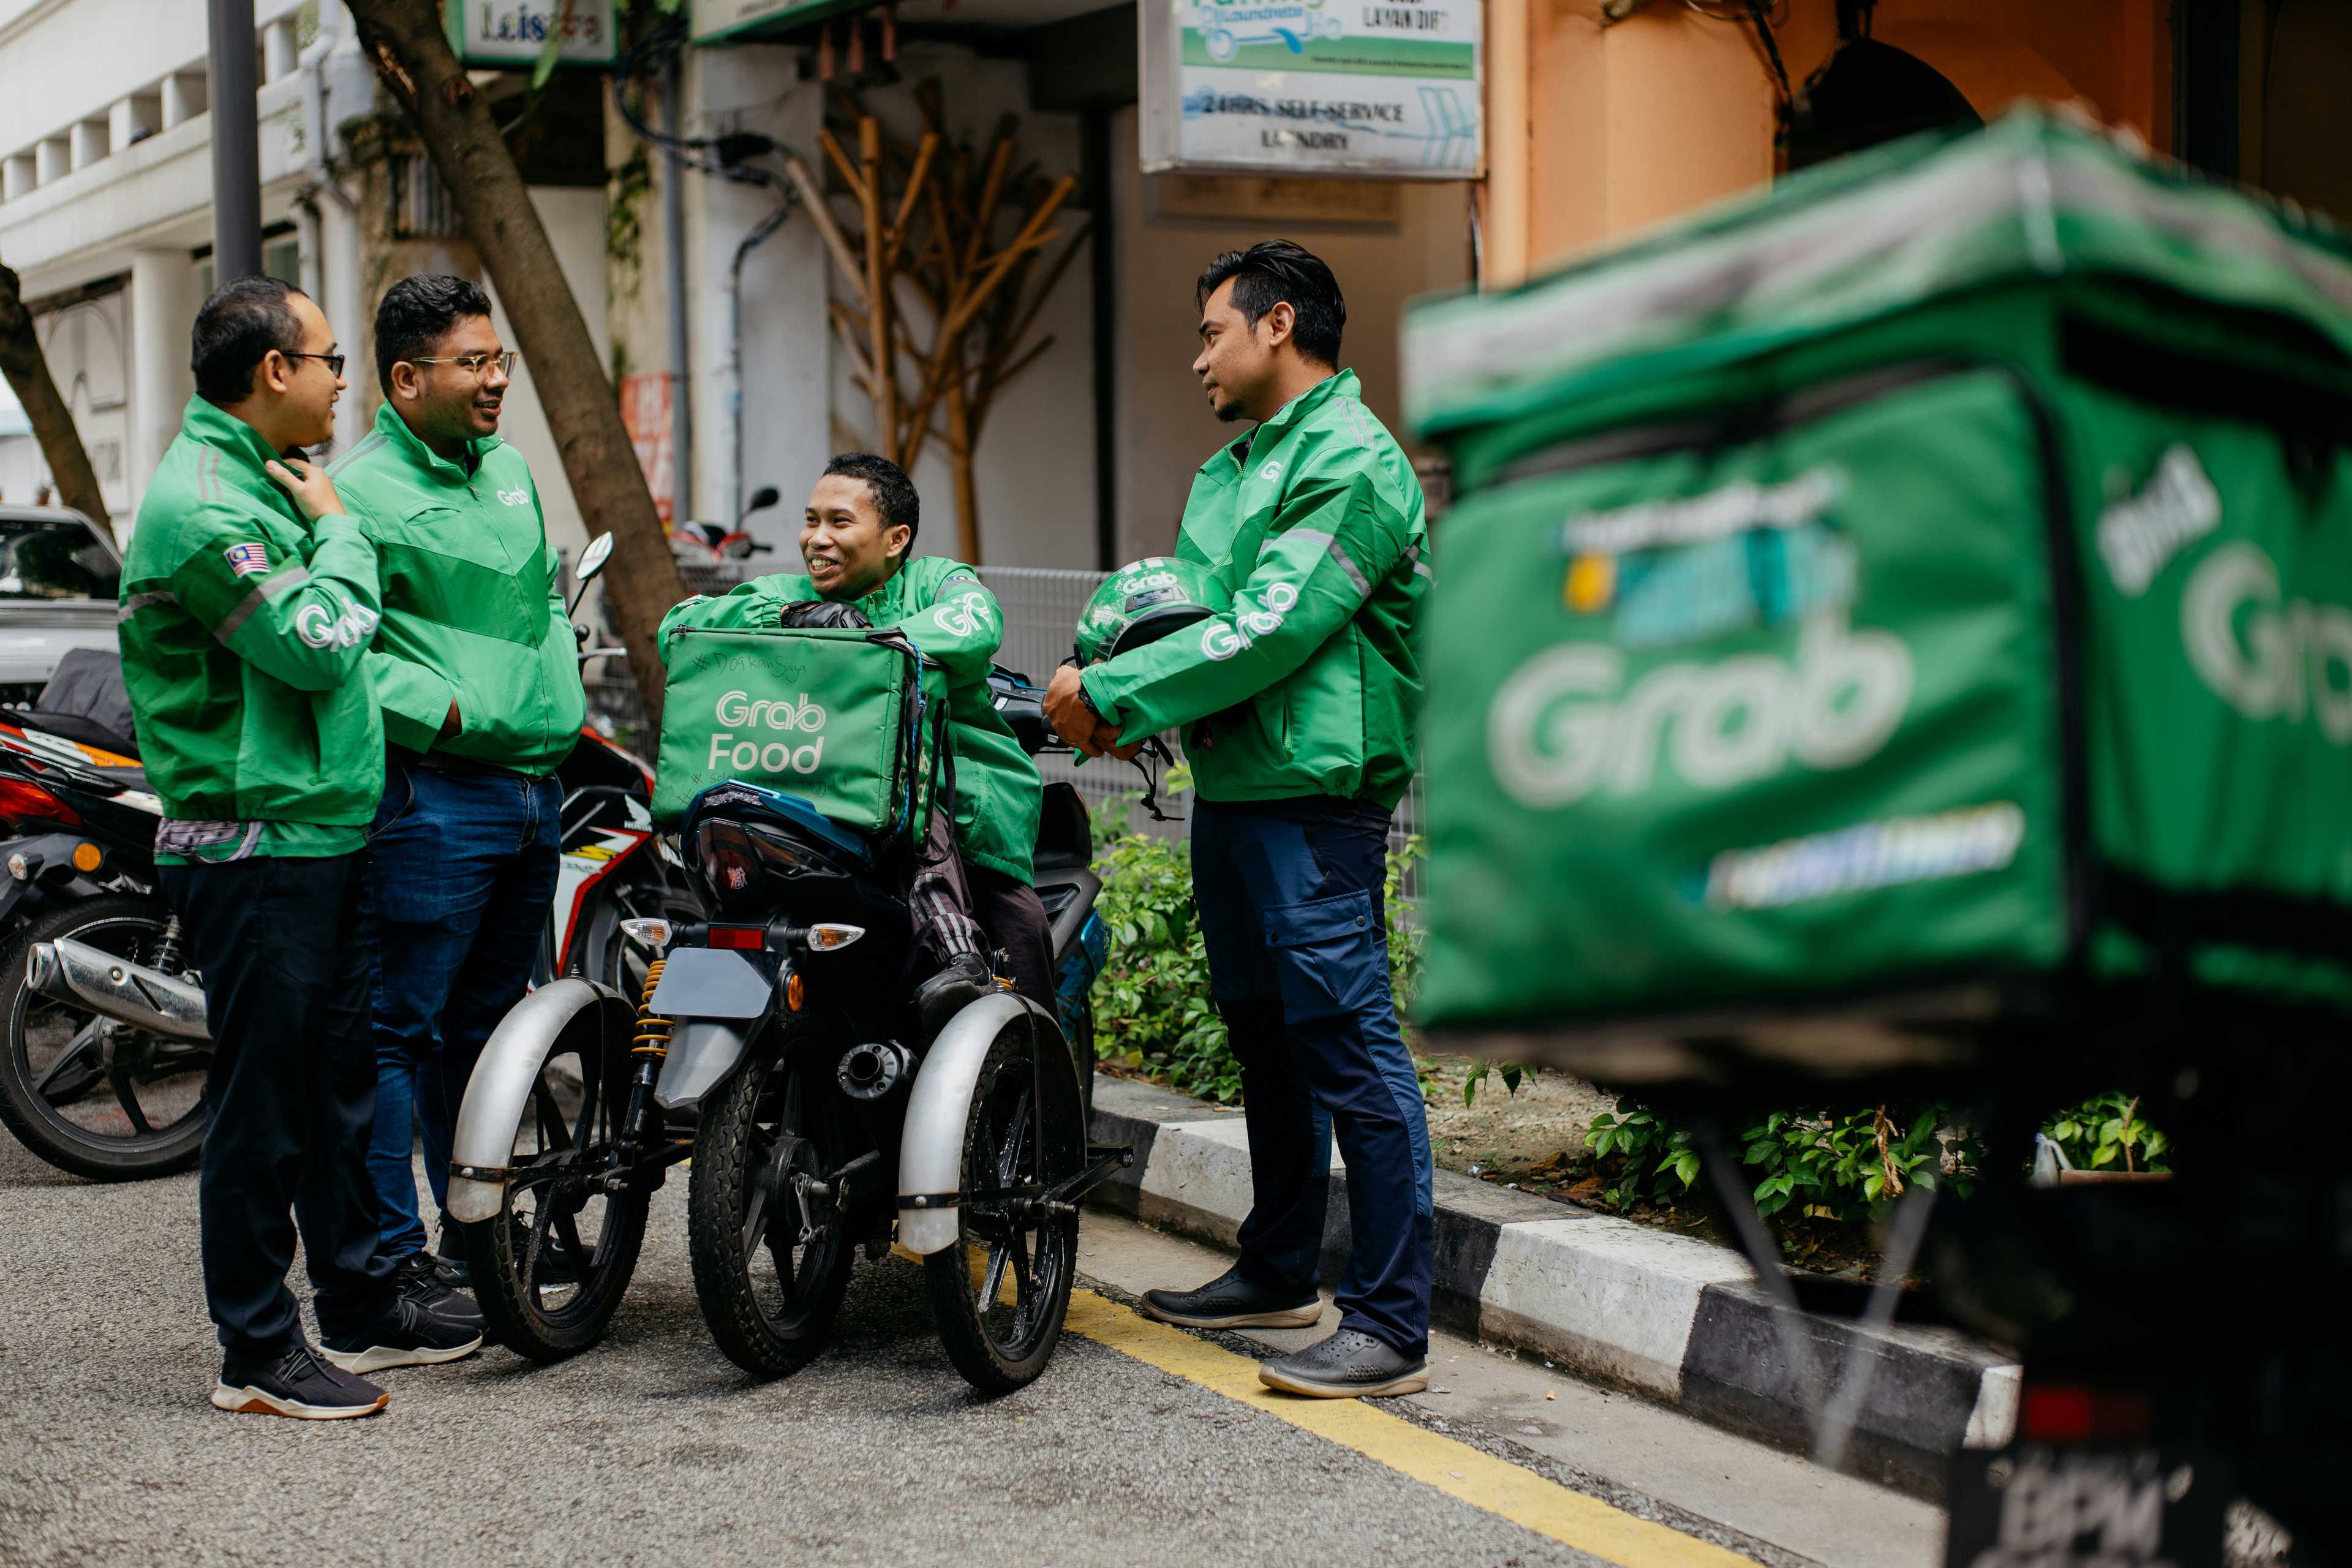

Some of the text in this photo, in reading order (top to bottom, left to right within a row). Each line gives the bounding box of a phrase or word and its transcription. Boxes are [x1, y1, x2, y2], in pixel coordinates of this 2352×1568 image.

[1261, 129, 1348, 149] LNDRY
[1123, 571, 1177, 594] Grab
[1200, 582, 1298, 662] Grab
[715, 690, 826, 733] Grab
[1487, 612, 1915, 809] Grab
[708, 733, 824, 774] Food
